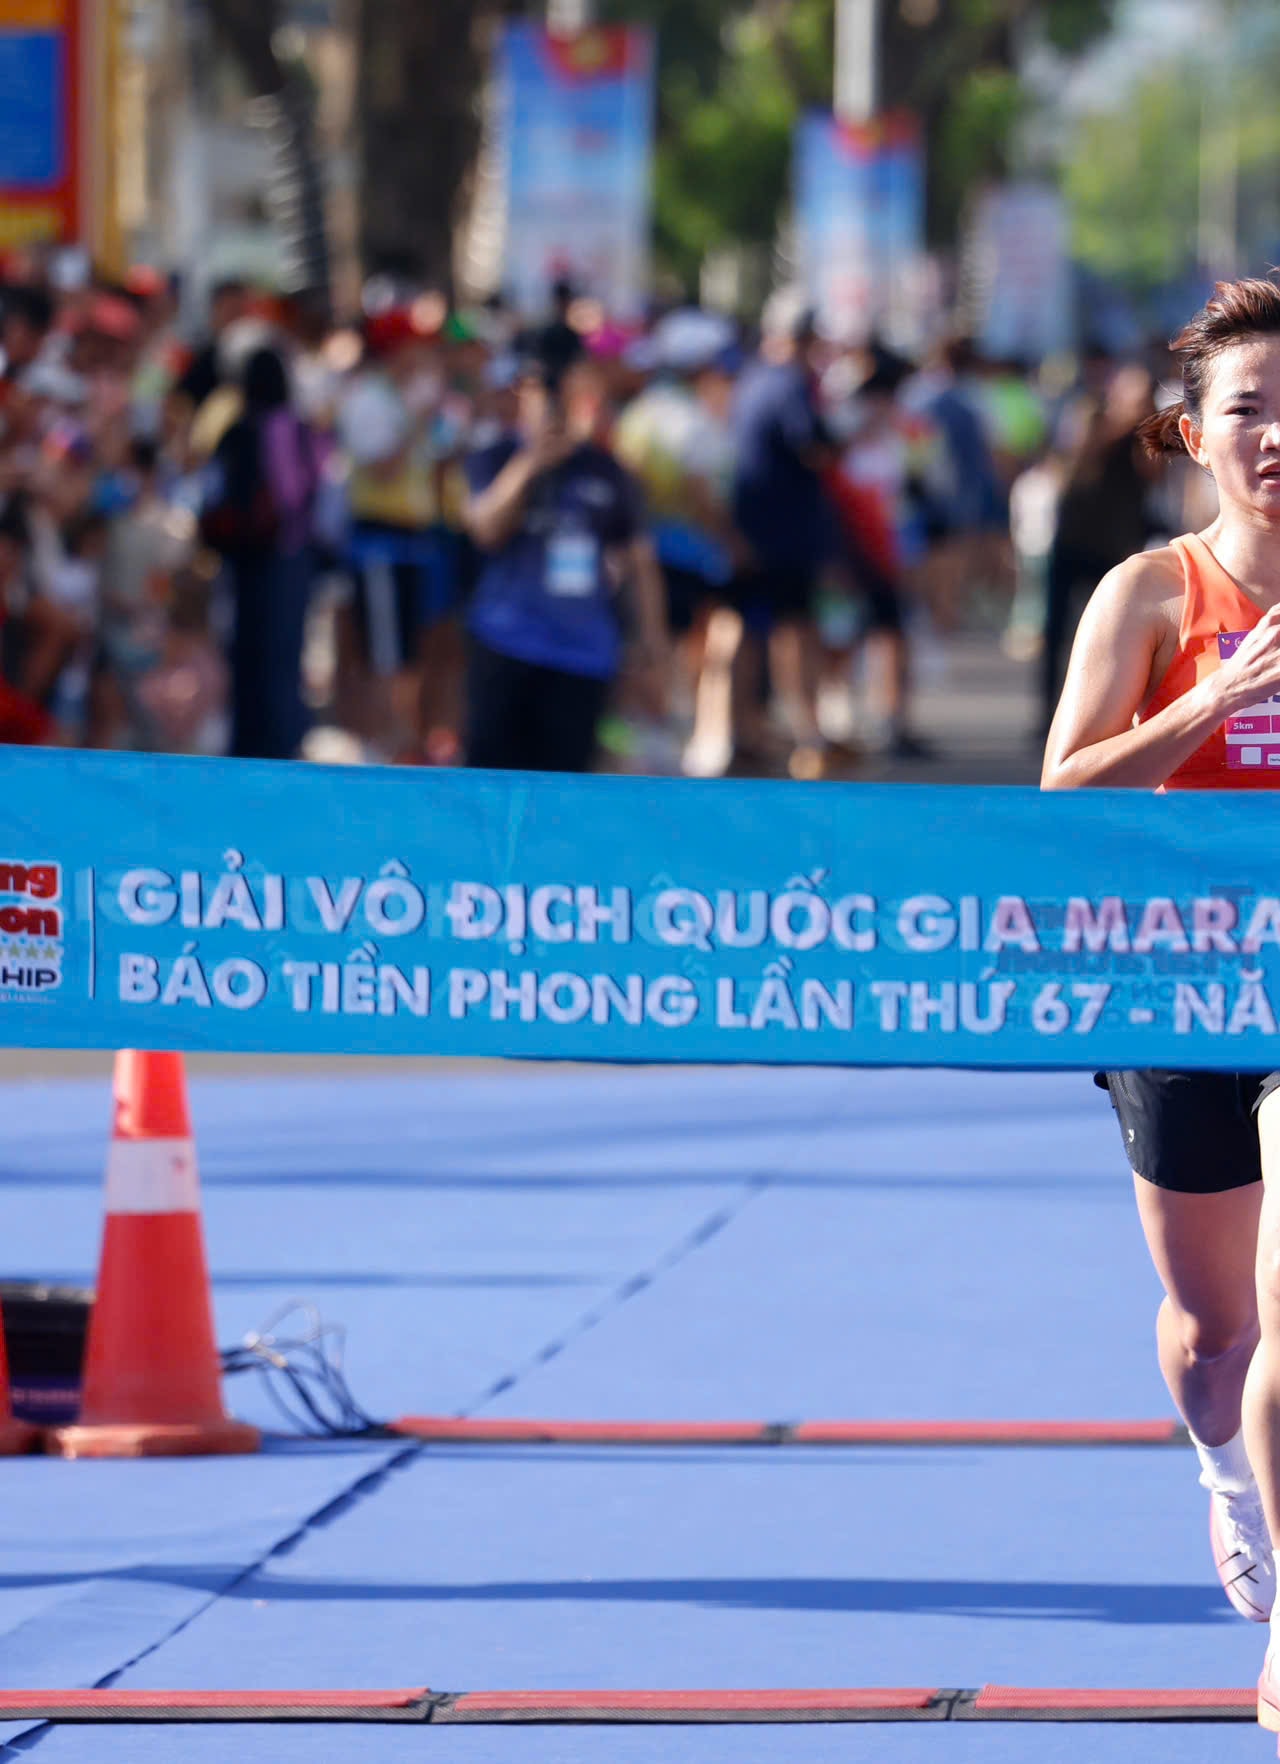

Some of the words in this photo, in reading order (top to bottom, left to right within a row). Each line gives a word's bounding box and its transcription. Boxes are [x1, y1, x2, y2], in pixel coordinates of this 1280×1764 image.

[1233, 722, 1254, 730] 5km
[118, 848, 284, 931] GIẢI
[306, 857, 426, 936] VÔ
[446, 880, 632, 956] ĐỊCH
[653, 867, 877, 952] QUỐC
[897, 894, 1041, 953] GIA
[118, 940, 269, 1010] BÁO
[282, 939, 431, 1017] TIỀN
[448, 967, 699, 1028] PHONG
[716, 954, 854, 1031] LẦN
[870, 966, 1017, 1034] THỨ
[1031, 983, 1113, 1035] 67
[1129, 1007, 1155, 1024] -
